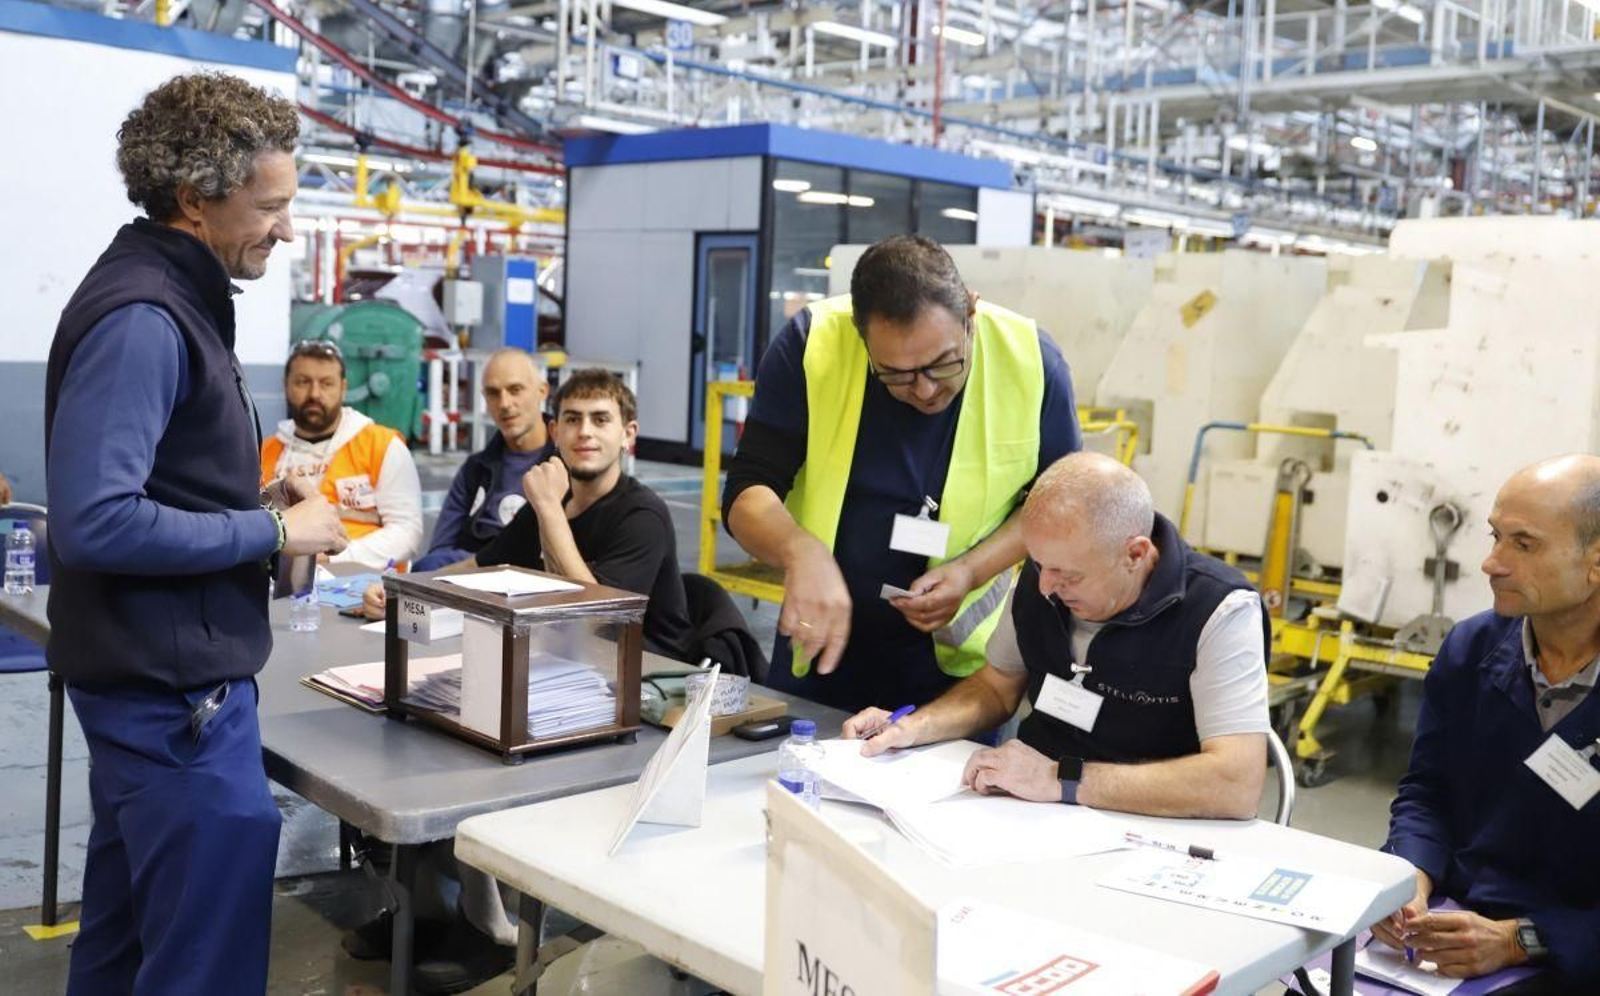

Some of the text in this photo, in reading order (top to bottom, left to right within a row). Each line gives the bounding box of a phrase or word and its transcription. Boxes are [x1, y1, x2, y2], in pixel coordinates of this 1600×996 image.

[667, 21, 693, 47] 30
[404, 600, 426, 617] MESA
[412, 622, 418, 634] 9
[1098, 683, 1179, 704] STELLANTIS
[796, 938, 856, 996] ME
